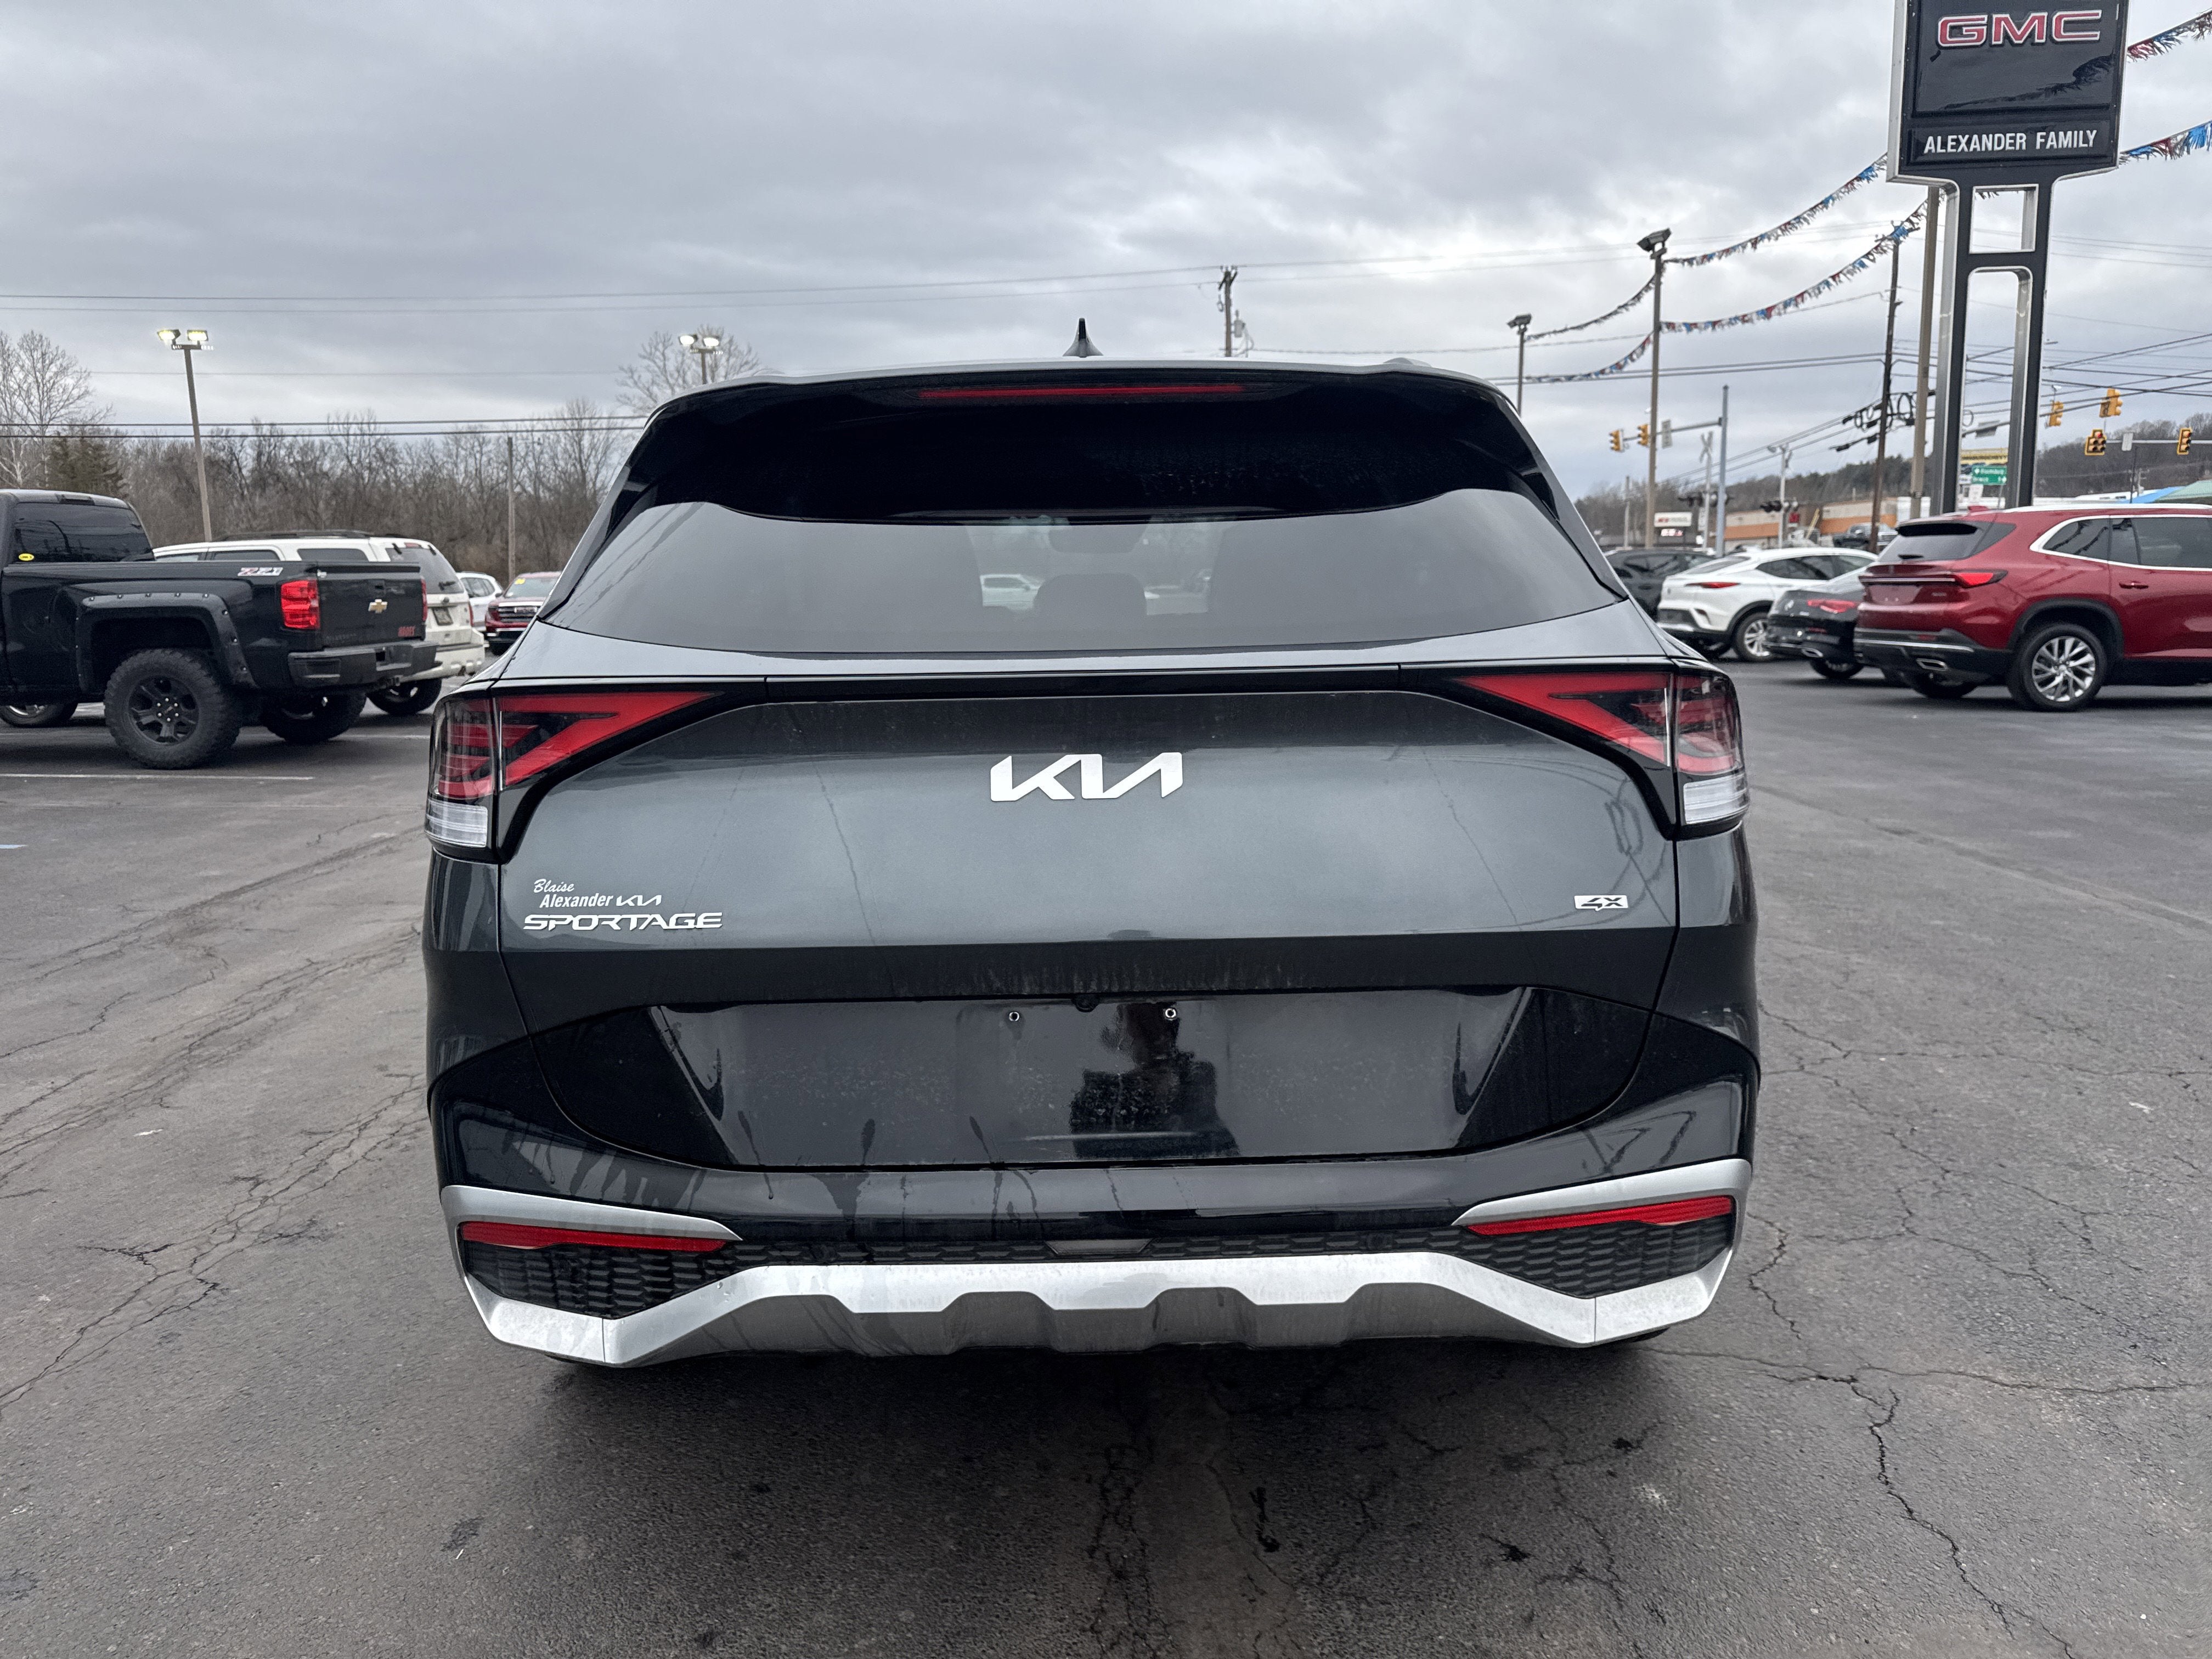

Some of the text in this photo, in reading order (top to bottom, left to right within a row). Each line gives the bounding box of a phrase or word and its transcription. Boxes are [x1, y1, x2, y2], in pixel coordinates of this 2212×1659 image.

[1938, 10, 2102, 46] GMC
[1924, 129, 2098, 154] ALEXANDER FAMILY
[990, 752, 1183, 802] KIA
[533, 878, 575, 893] Blaise
[539, 893, 662, 909] Alexander KIA
[523, 912, 723, 931] SPORTAGE
